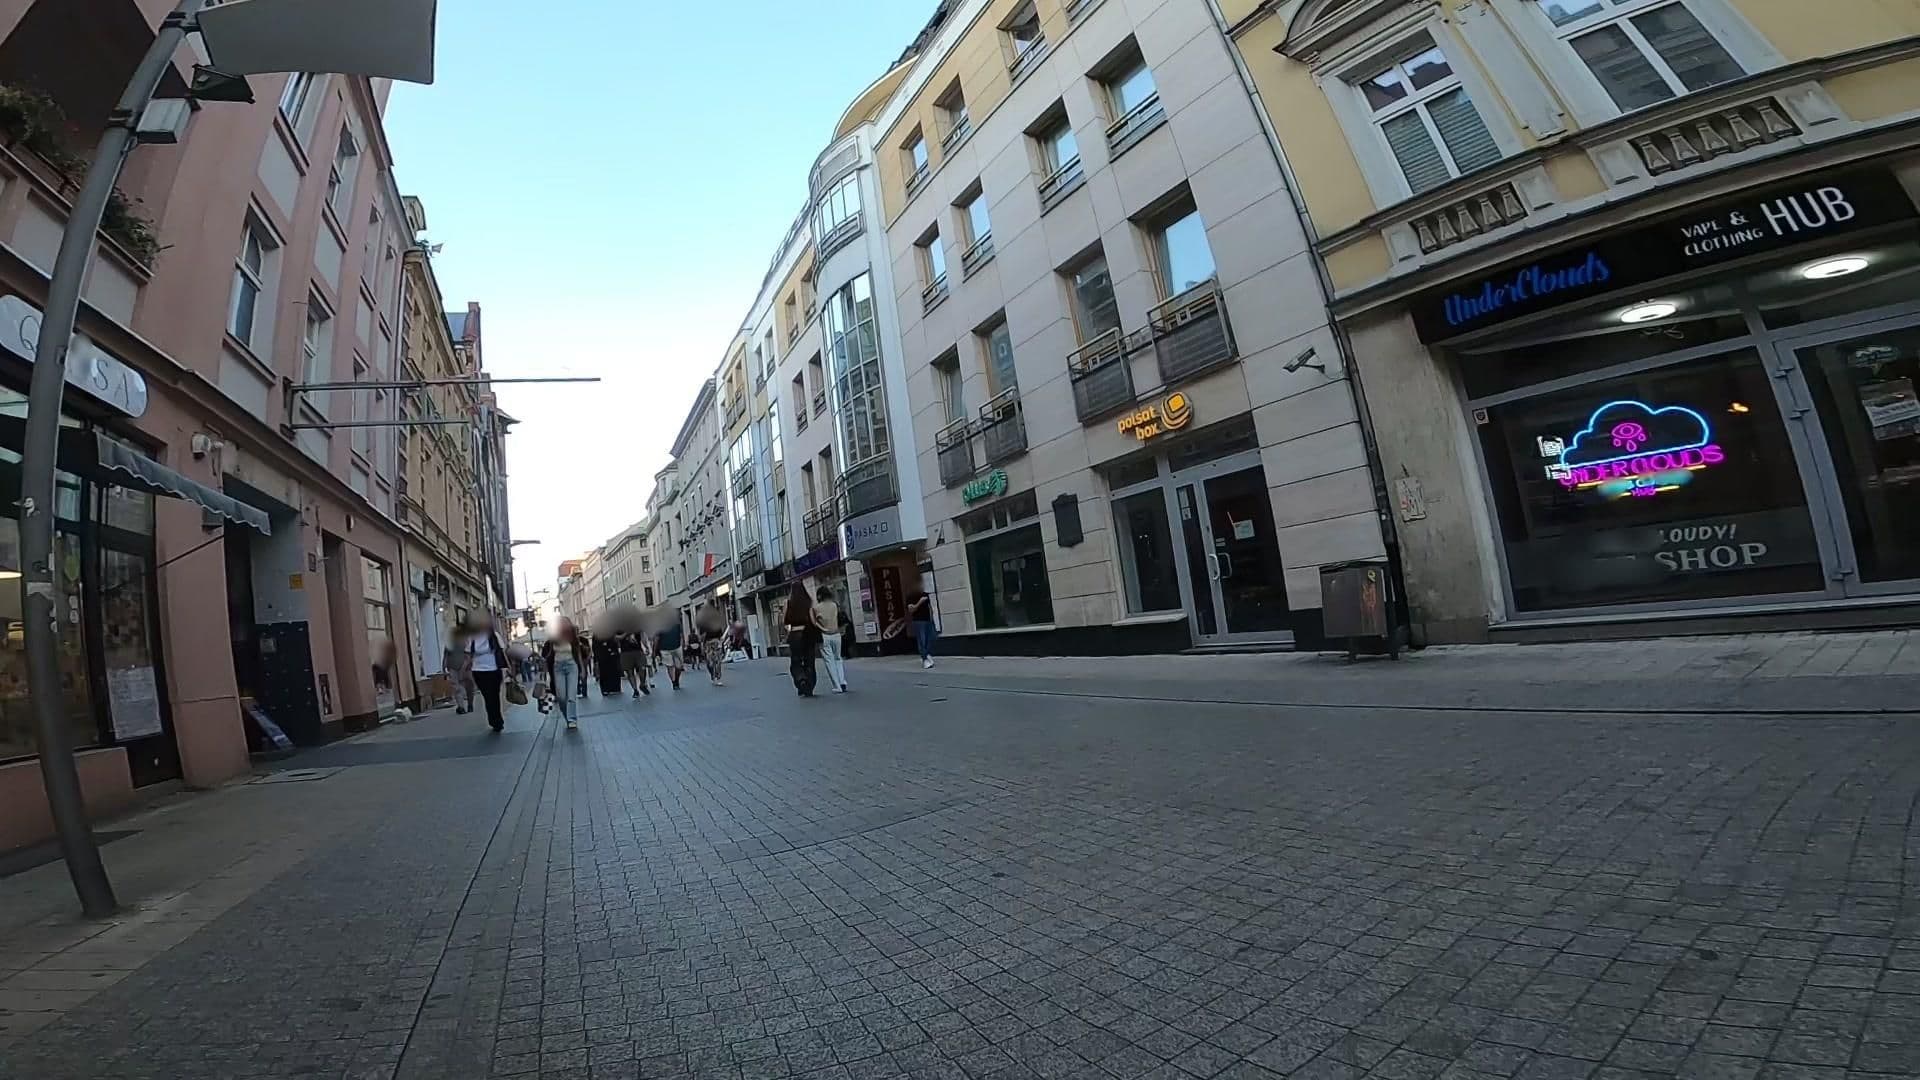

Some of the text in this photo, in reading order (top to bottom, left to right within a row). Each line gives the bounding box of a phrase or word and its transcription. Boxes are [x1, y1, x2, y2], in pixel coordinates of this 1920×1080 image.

[1681, 211, 1750, 239] VAPE &
[1760, 187, 1856, 236] HUB
[1684, 227, 1764, 256] CLOTHING
[1444, 252, 1612, 326] UnderClouds
[1117, 405, 1157, 434] polsat
[1135, 423, 1159, 440] box
[1654, 542, 1767, 571] SHOP
